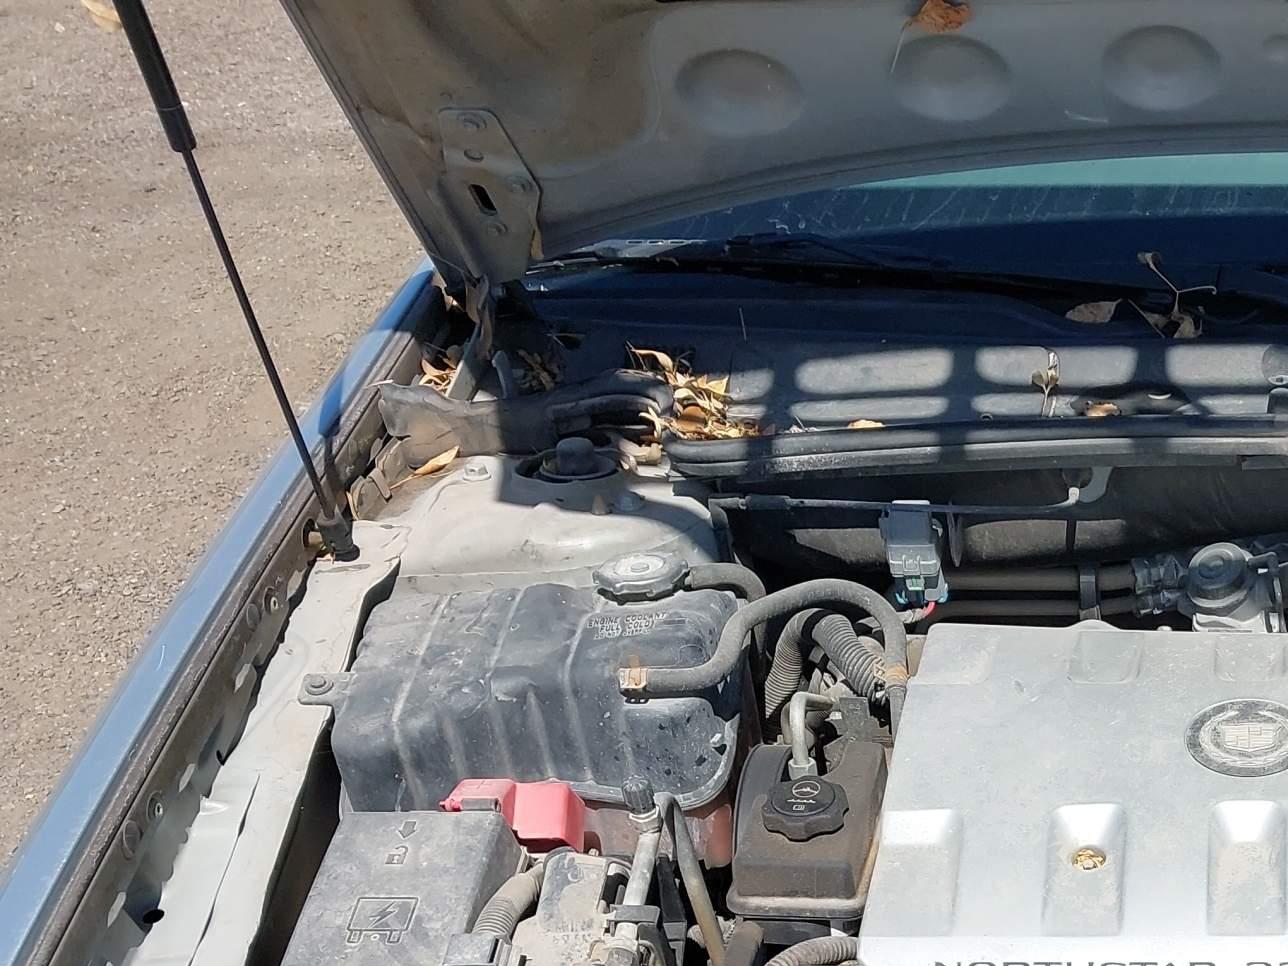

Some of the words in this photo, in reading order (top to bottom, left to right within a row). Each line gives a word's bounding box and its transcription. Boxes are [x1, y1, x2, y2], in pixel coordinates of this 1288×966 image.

[588, 616, 620, 628] ENGINE
[625, 612, 667, 622] COOLANT
[600, 624, 621, 633] FULL
